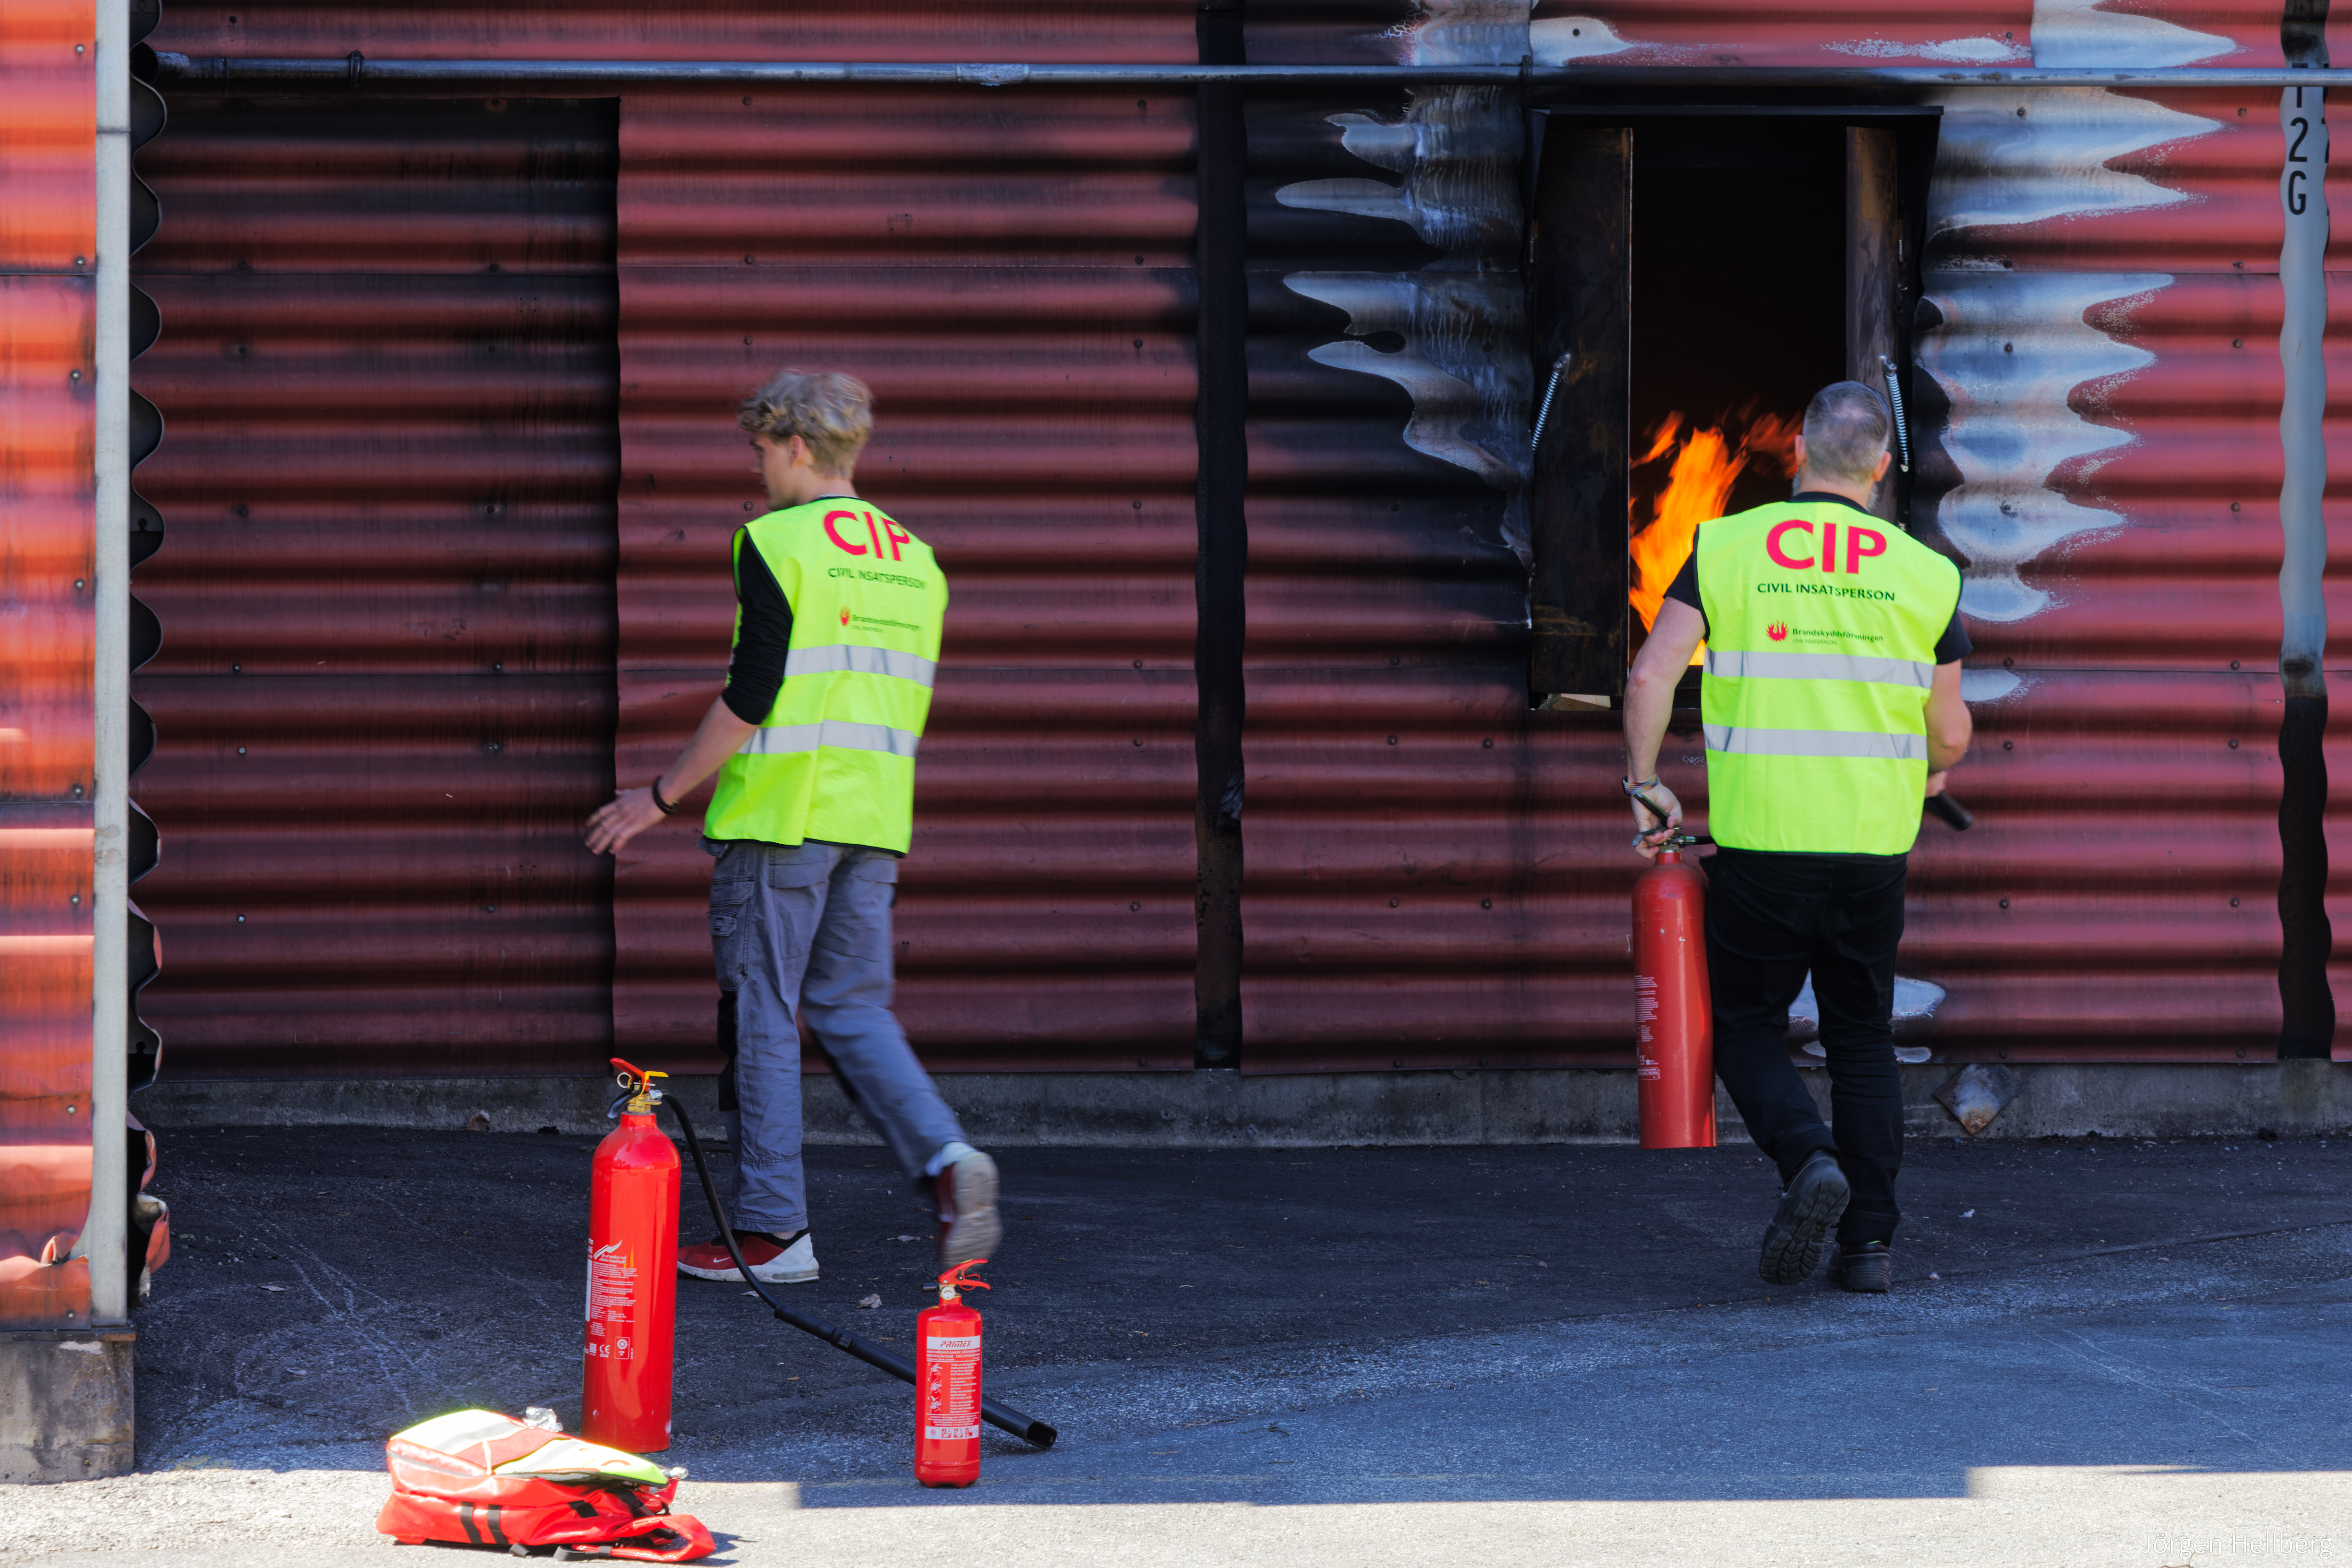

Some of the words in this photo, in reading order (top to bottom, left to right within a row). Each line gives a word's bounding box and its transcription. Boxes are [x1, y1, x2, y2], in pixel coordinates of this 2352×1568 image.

[823, 510, 910, 561] CIP
[1766, 519, 1887, 574] CIP
[828, 567, 854, 578] CIVIL
[856, 569, 926, 589] INSATSPERSON
[1757, 583, 1792, 593] CIVIL
[1796, 584, 1895, 601] INSATSPERSON
[1792, 628, 1883, 643] Brandskyddsföreningen
[600, 1344, 610, 1354] CE
